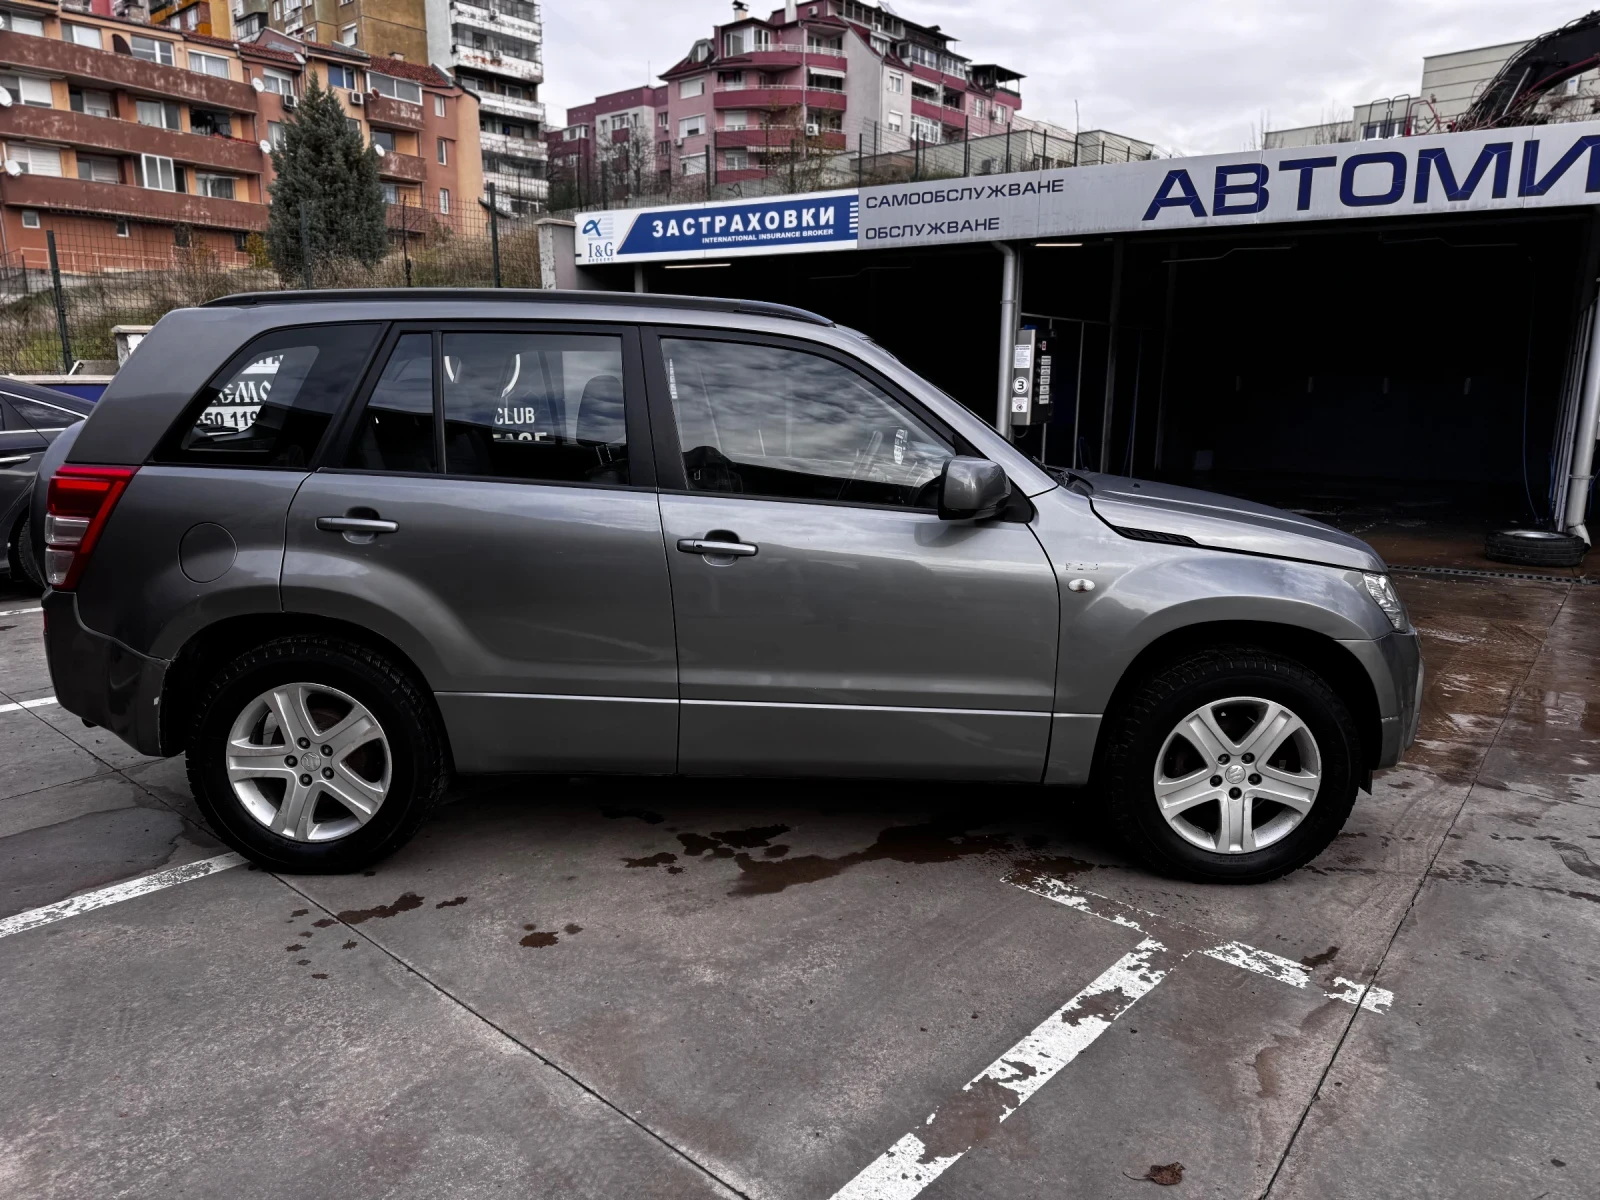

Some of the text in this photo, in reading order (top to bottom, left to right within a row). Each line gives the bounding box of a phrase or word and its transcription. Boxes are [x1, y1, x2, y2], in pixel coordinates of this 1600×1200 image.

[1142, 135, 1600, 221] АВТОМИ
[865, 179, 1065, 209] САМООБСЛУЖВАНЕ
[652, 206, 835, 238] ЗАСТРАХОВКИ
[865, 217, 1000, 240] ОБСЛУЖВАНЕ
[702, 229, 834, 244] INTERNATIONAL INSURANCE BROKER
[588, 241, 614, 258] I&G
[1017, 381, 1025, 390] 3
[494, 407, 535, 425] CLUB
